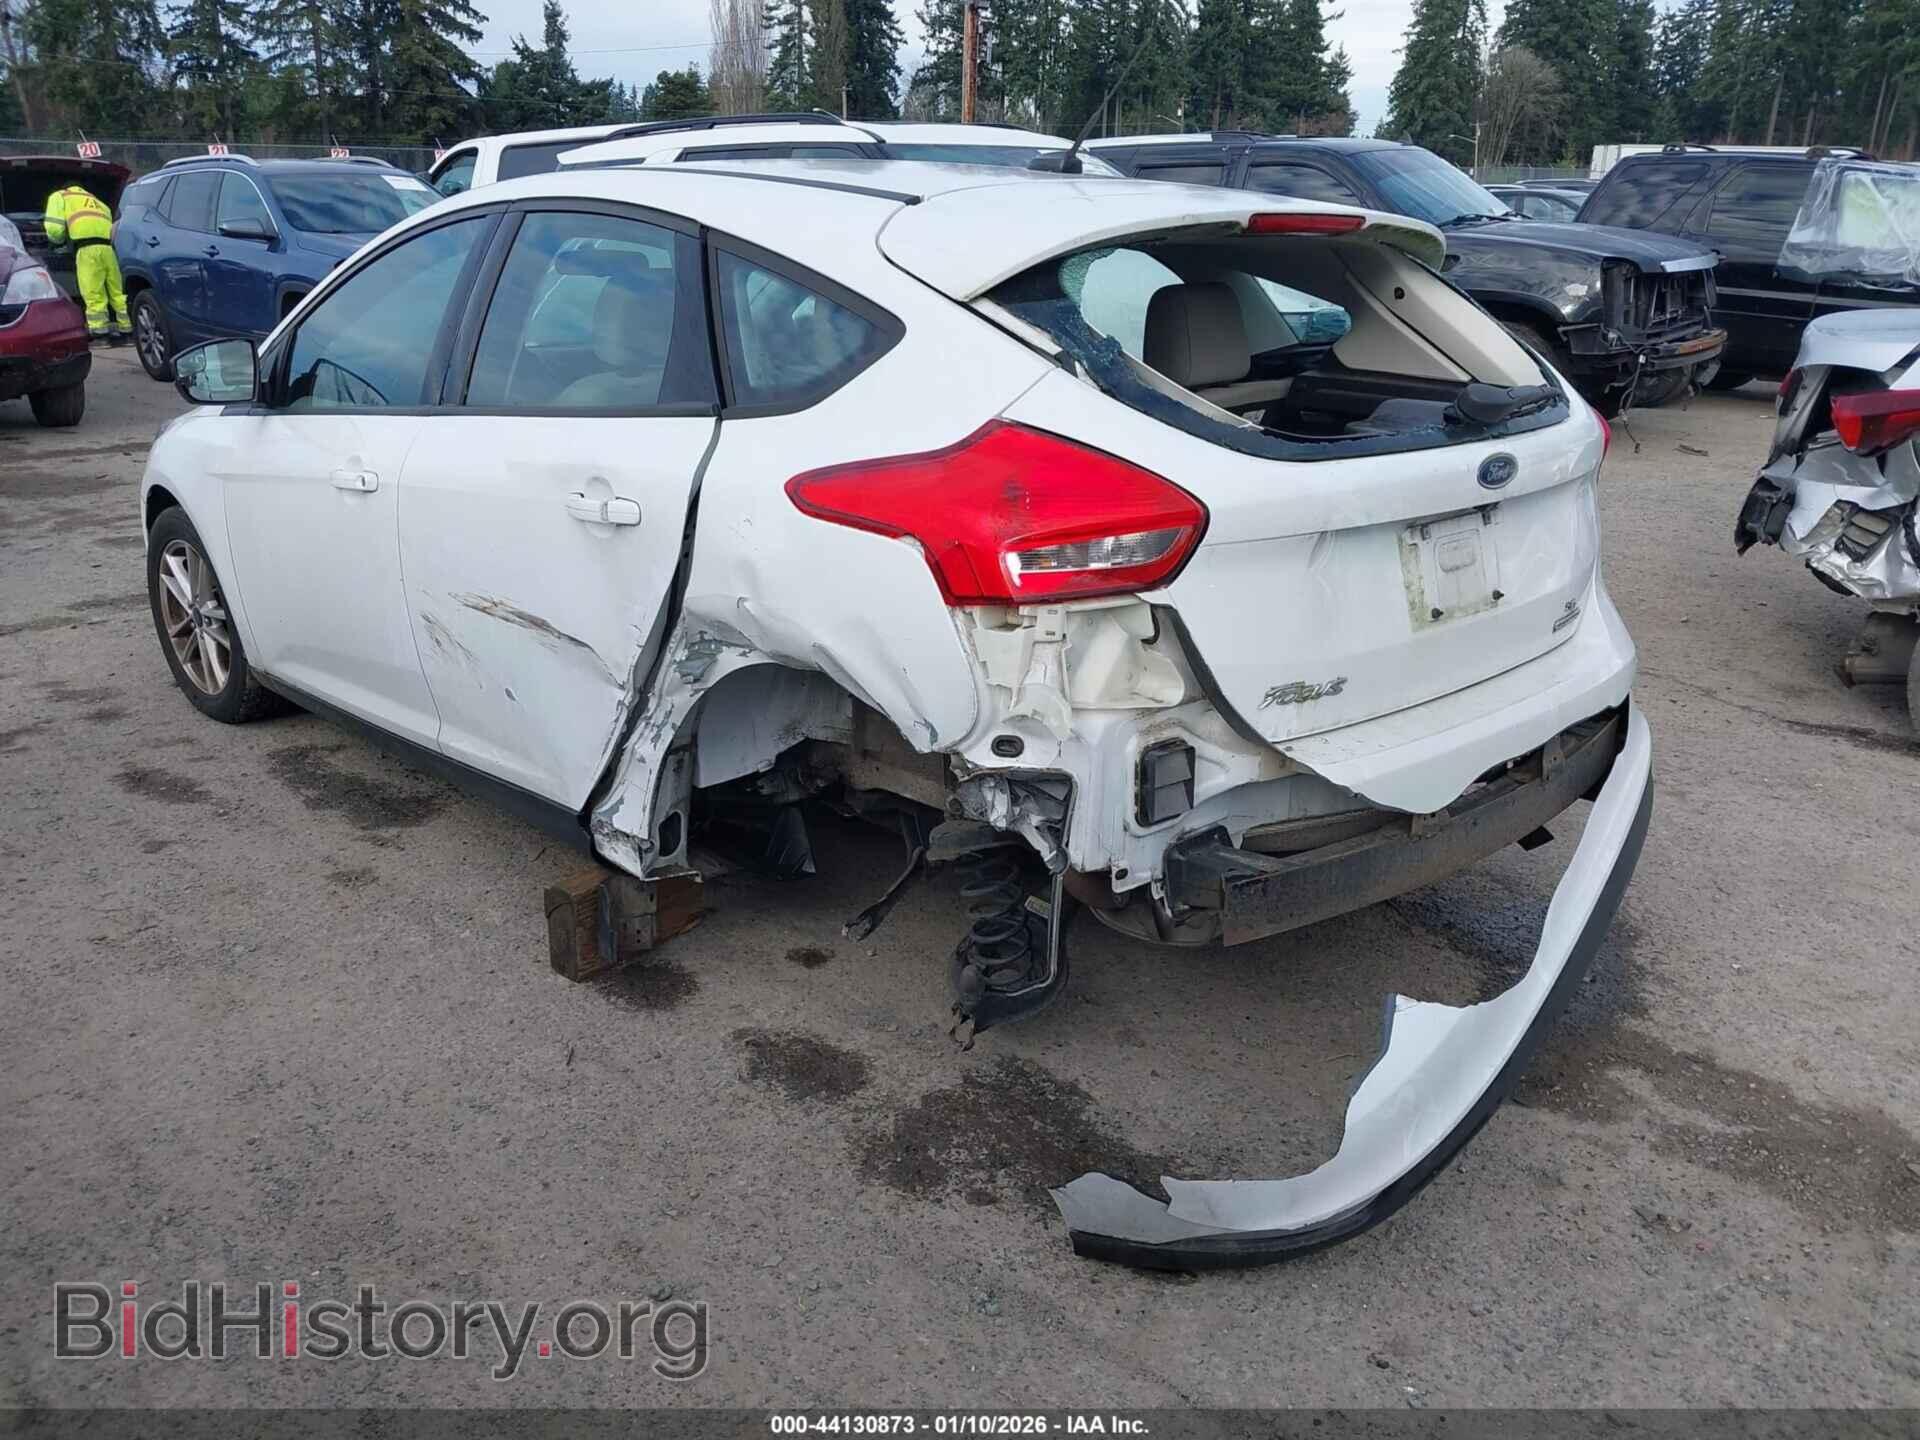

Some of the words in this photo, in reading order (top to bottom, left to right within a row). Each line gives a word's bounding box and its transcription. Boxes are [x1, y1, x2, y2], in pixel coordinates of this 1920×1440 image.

[80, 143, 98, 157] 20
[211, 144, 225, 156] 21
[1486, 461, 1511, 481] Ford
